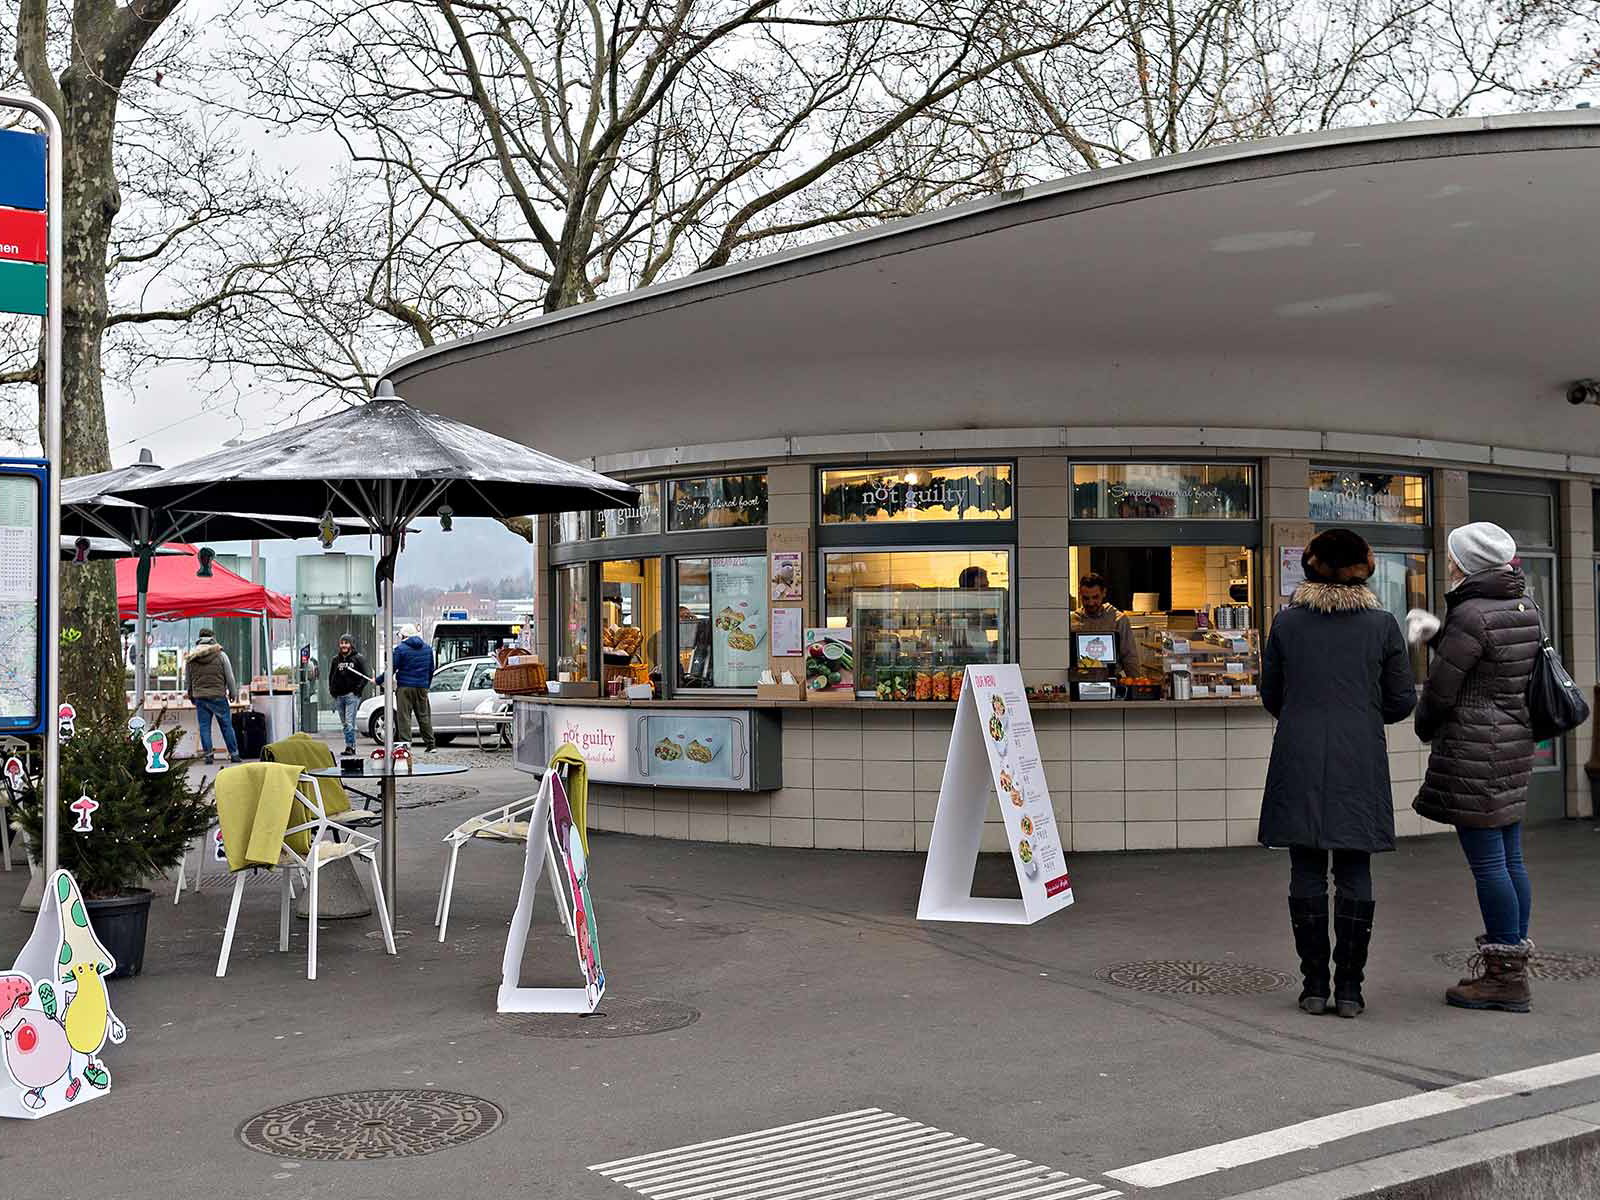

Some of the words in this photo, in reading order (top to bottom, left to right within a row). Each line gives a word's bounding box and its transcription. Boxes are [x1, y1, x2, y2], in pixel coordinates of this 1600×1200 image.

[861, 487, 899, 504] not
[904, 484, 968, 508] guilty
[1111, 485, 1153, 503] Simply
[1154, 487, 1194, 497] natural
[1194, 486, 1219, 500] food
[676, 497, 705, 515] Simply
[706, 499, 737, 509] natural
[738, 495, 760, 507] food
[563, 729, 580, 744] not
[582, 729, 616, 751] guilty
